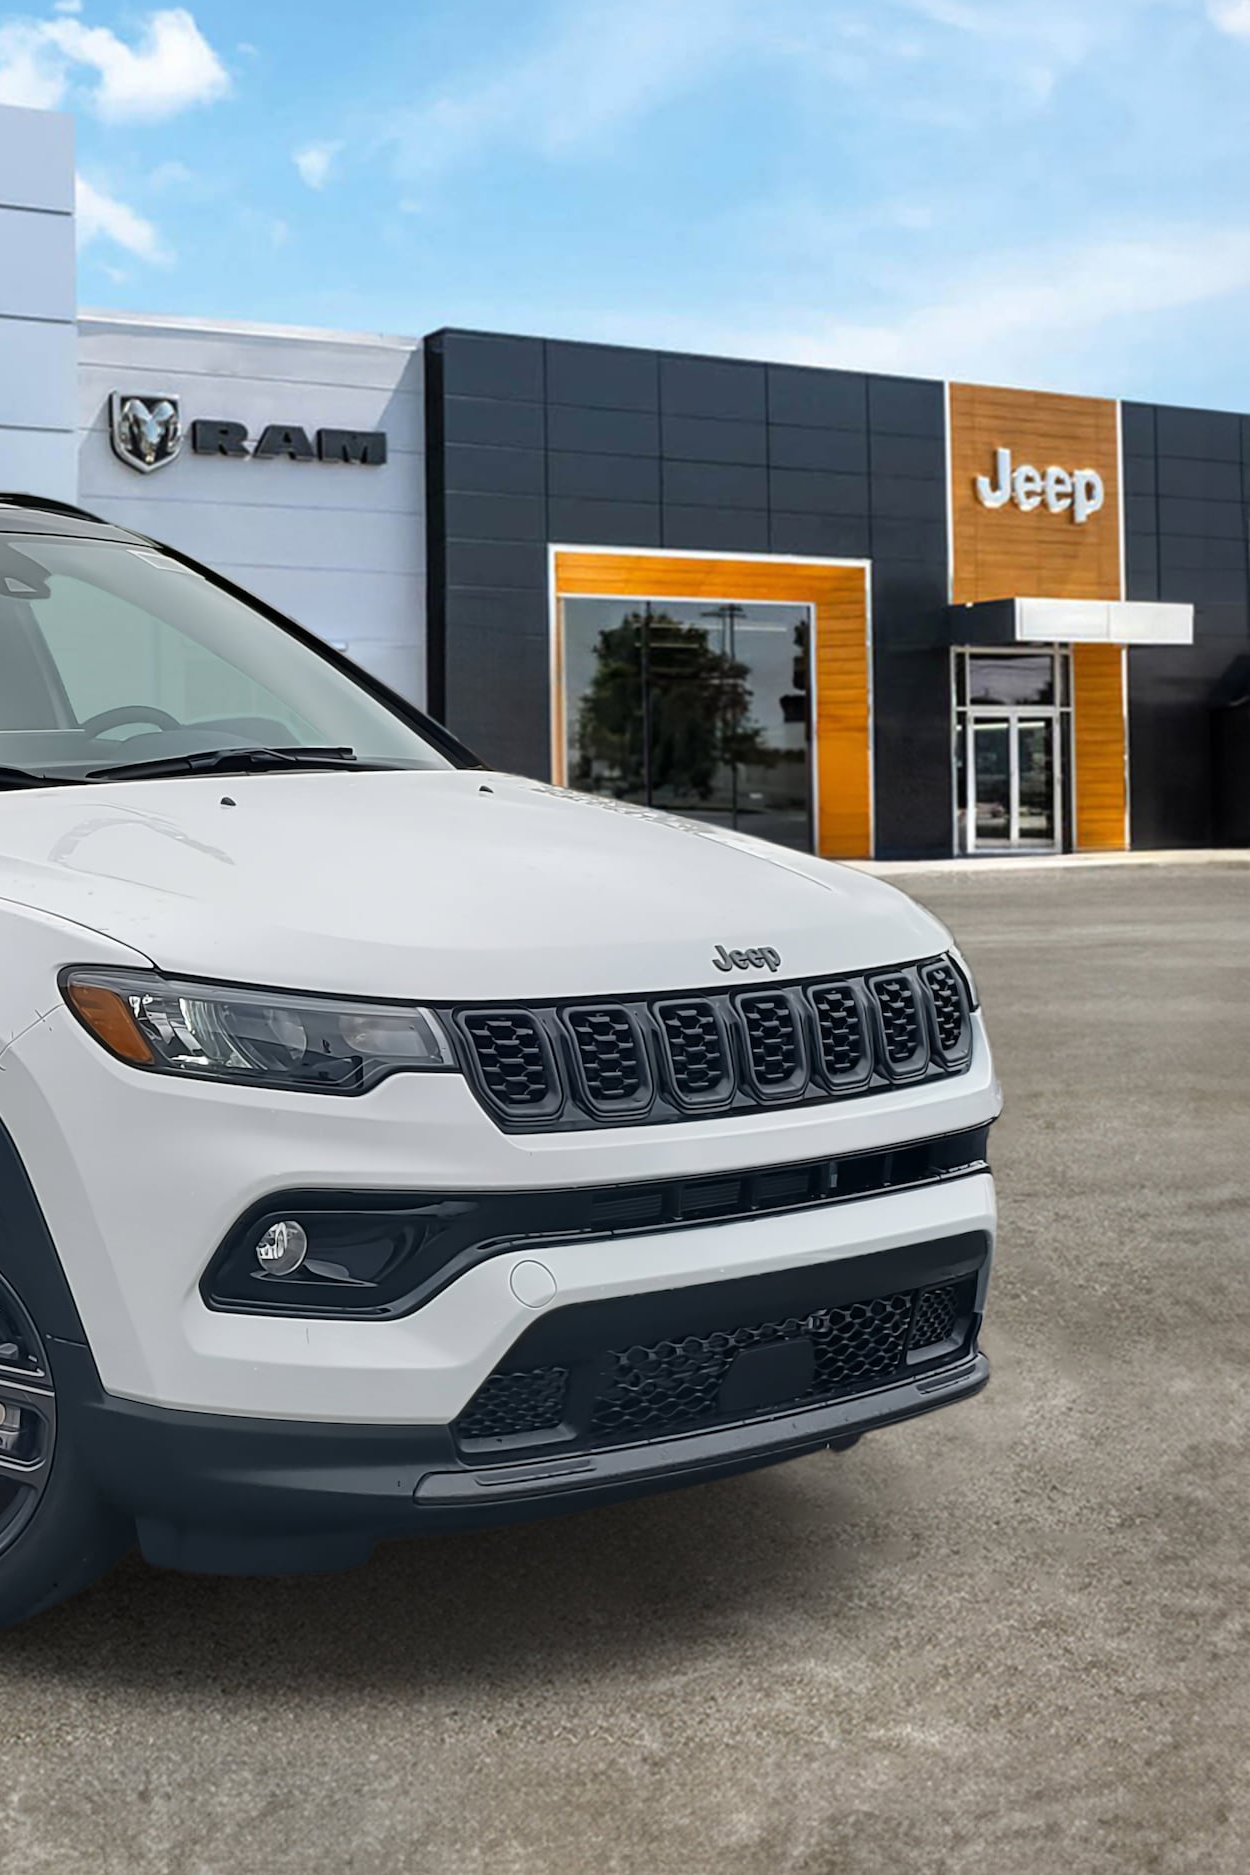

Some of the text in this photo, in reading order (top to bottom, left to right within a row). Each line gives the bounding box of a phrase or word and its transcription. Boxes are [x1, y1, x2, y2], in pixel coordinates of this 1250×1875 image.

[191, 419, 387, 466] RAM
[975, 447, 1104, 524] Jeep
[712, 945, 781, 972] Jeep
